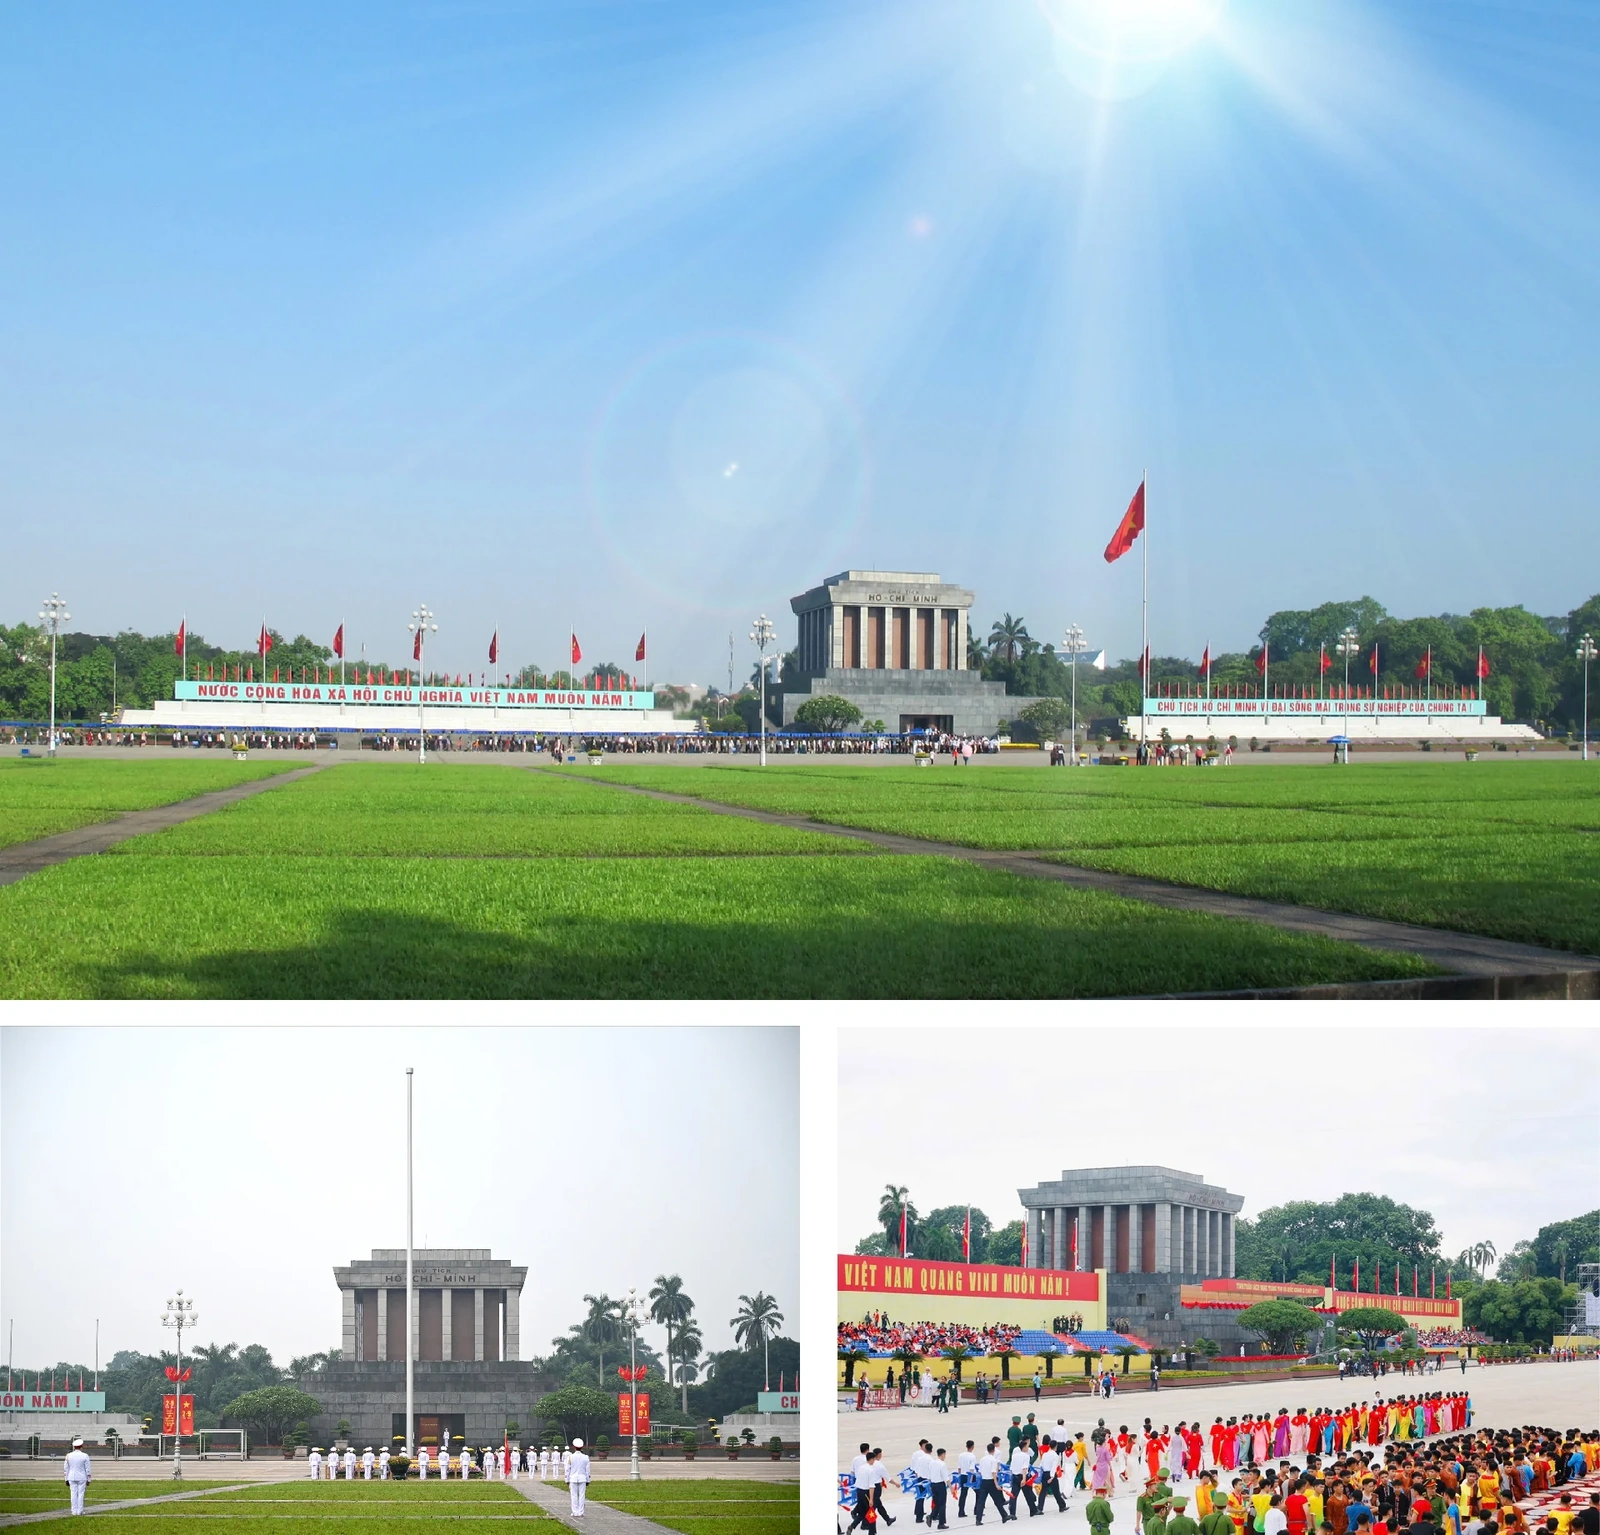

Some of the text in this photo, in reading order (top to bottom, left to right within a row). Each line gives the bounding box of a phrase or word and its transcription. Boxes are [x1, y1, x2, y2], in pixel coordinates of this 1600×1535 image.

[198, 683, 239, 697] NƯỚC
[245, 684, 286, 701] CỘNG
[292, 685, 321, 699] HÒA
[328, 686, 346, 700] XÃ
[353, 687, 378, 702] HỘI
[384, 687, 412, 701] CHỦ
[419, 689, 462, 702] NGHĨA
[470, 690, 500, 705] VIỆT
[507, 693, 538, 703] NAM
[545, 691, 585, 704] MUÔN
[592, 692, 622, 705] NĂM
[1158, 700, 1175, 712] CHỦ
[1179, 702, 1198, 713] TỊCH
[1235, 702, 1256, 712] MINH
[1272, 702, 1286, 714] ĐẠI
[1289, 699, 1312, 712] SỐNG
[1364, 702, 1375, 714] SỰ
[1410, 701, 1425, 712] CỦA
[1428, 701, 1454, 712] CHÚNG
[1457, 703, 1467, 712] TA
[844, 1261, 877, 1291] VIỆT
[884, 1265, 913, 1289] NAM
[920, 1267, 963, 1292] QUANG
[968, 1271, 998, 1292] VINH
[1003, 1271, 1035, 1294] MUÔN
[0, 1393, 80, 1408] ÔN NĂM !
[781, 1396, 800, 1408] CH
